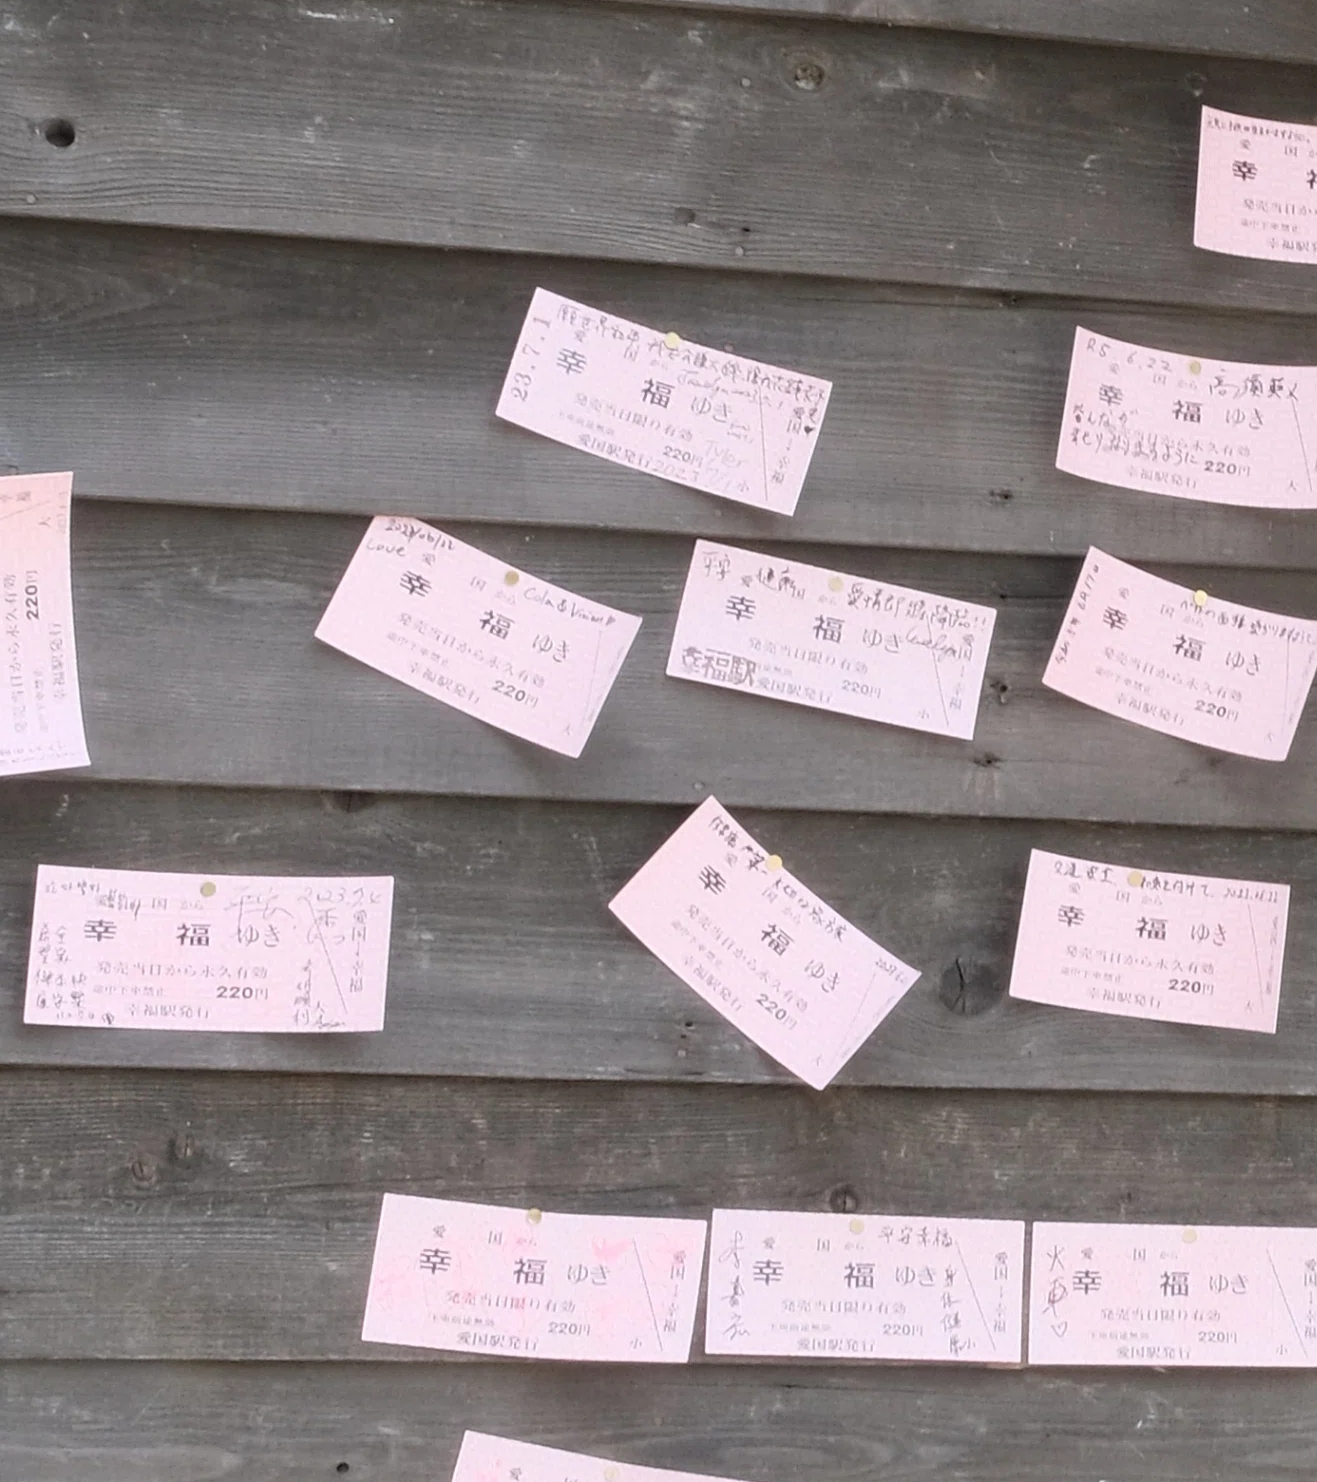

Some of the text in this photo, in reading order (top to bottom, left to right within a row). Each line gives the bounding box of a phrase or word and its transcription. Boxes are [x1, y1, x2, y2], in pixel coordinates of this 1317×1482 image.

[662, 442, 704, 467] 220円
[1204, 459, 1251, 477] 220円
[490, 678, 540, 709] 220円
[840, 679, 881, 698] 220円
[1192, 698, 1241, 721] 220円
[216, 985, 269, 1000] 220円
[1168, 978, 1214, 995] 220円
[753, 991, 801, 1031] 220円
[547, 1321, 591, 1336] 220円
[882, 1323, 924, 1337] 220円
[1197, 1330, 1237, 1343] 220円
